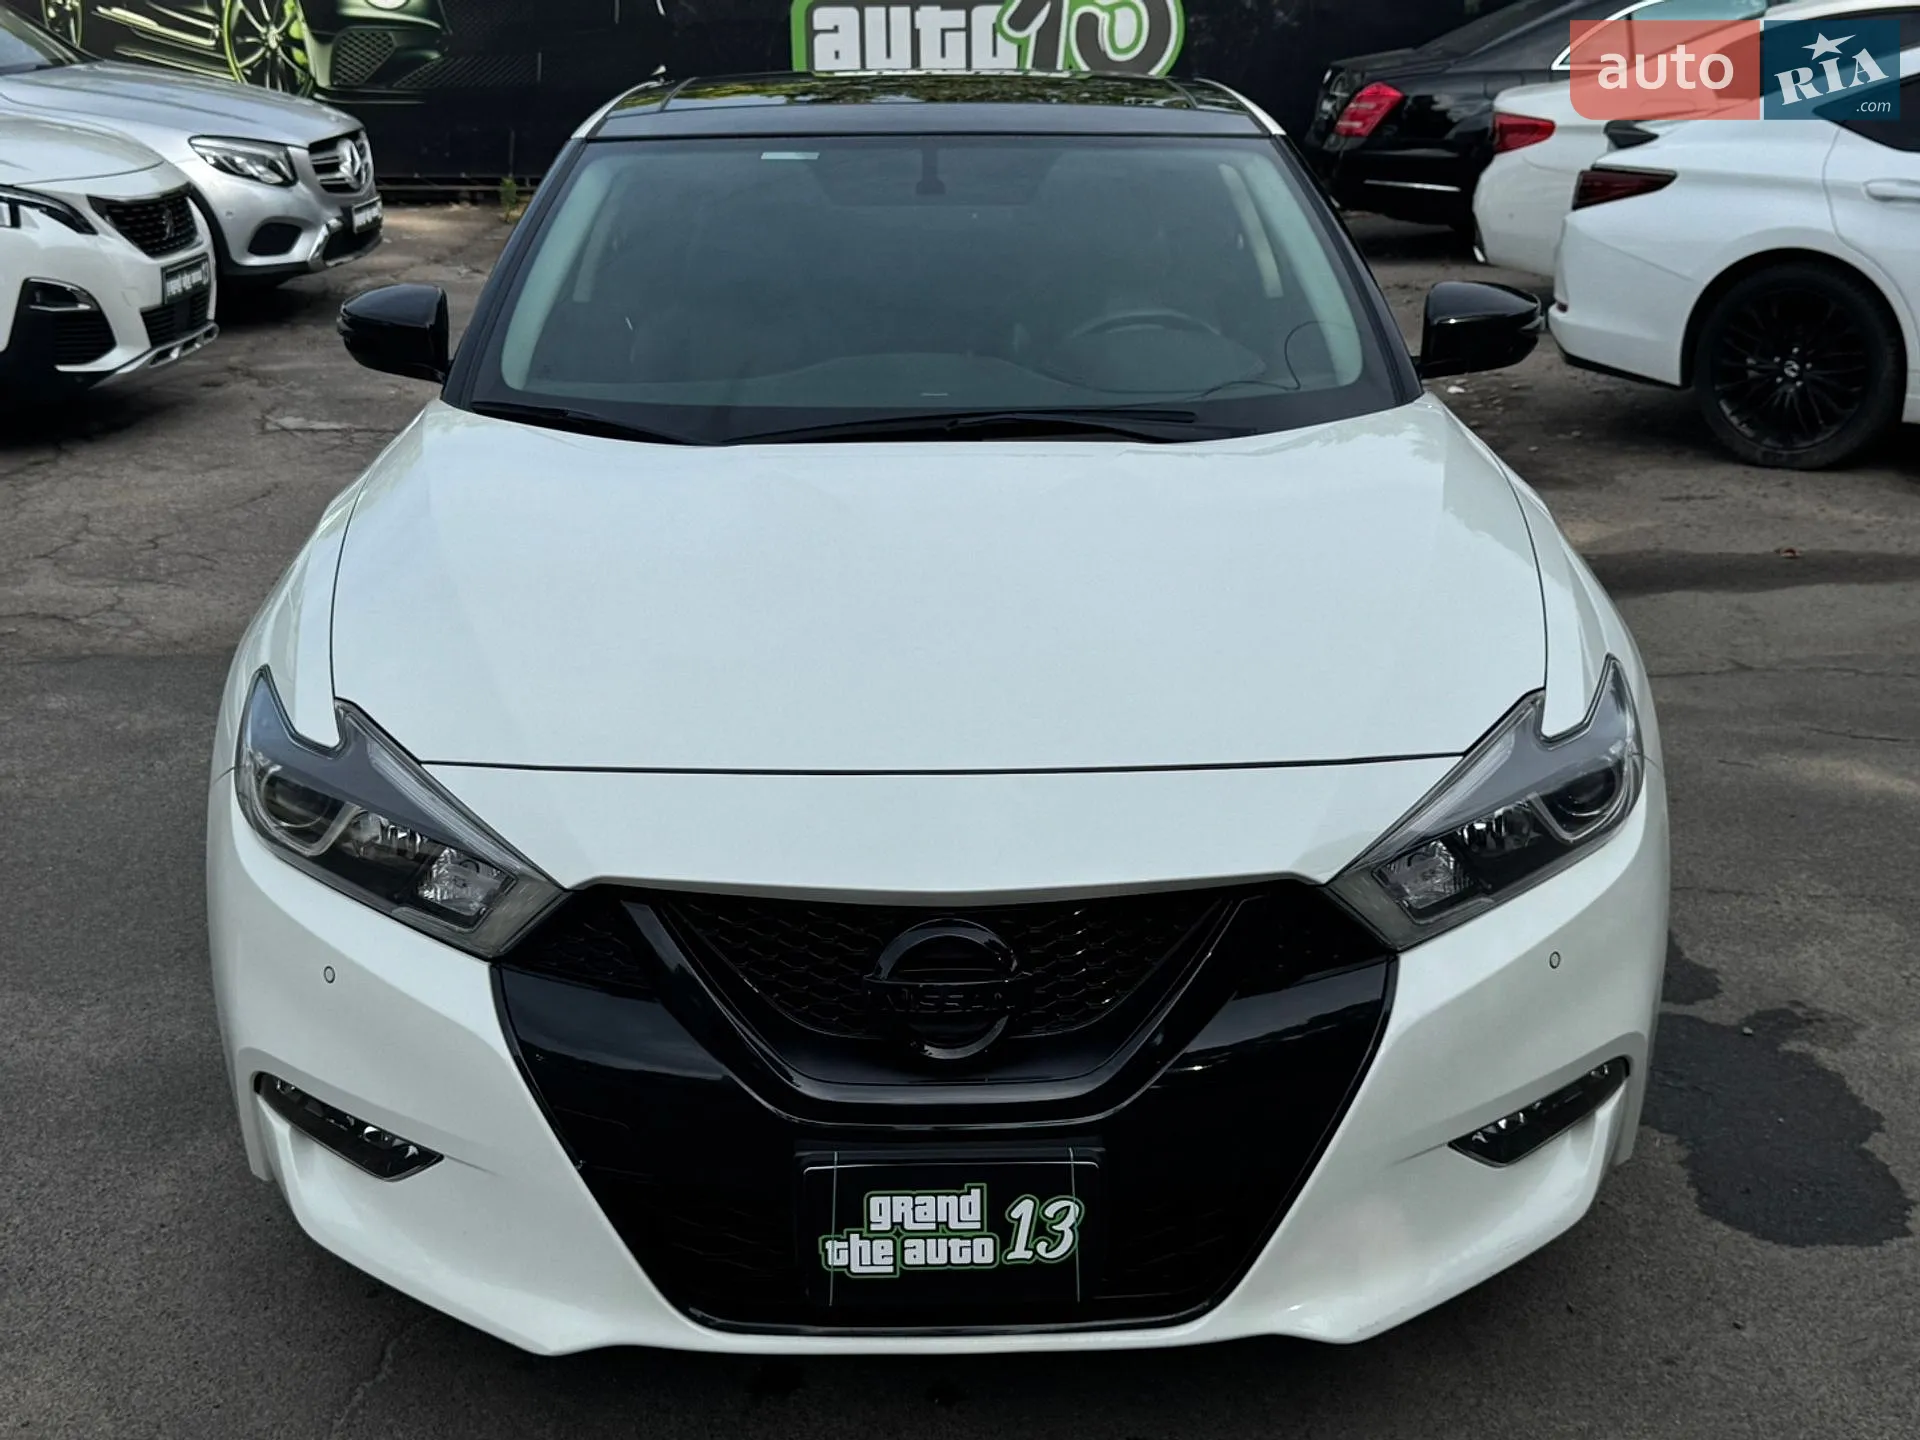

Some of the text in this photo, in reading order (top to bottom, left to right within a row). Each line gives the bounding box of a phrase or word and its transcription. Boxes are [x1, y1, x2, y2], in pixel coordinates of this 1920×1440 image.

[812, 4, 1019, 72] auto
[825, 1233, 995, 1274] the auto
[1005, 1198, 1081, 1261] 13
